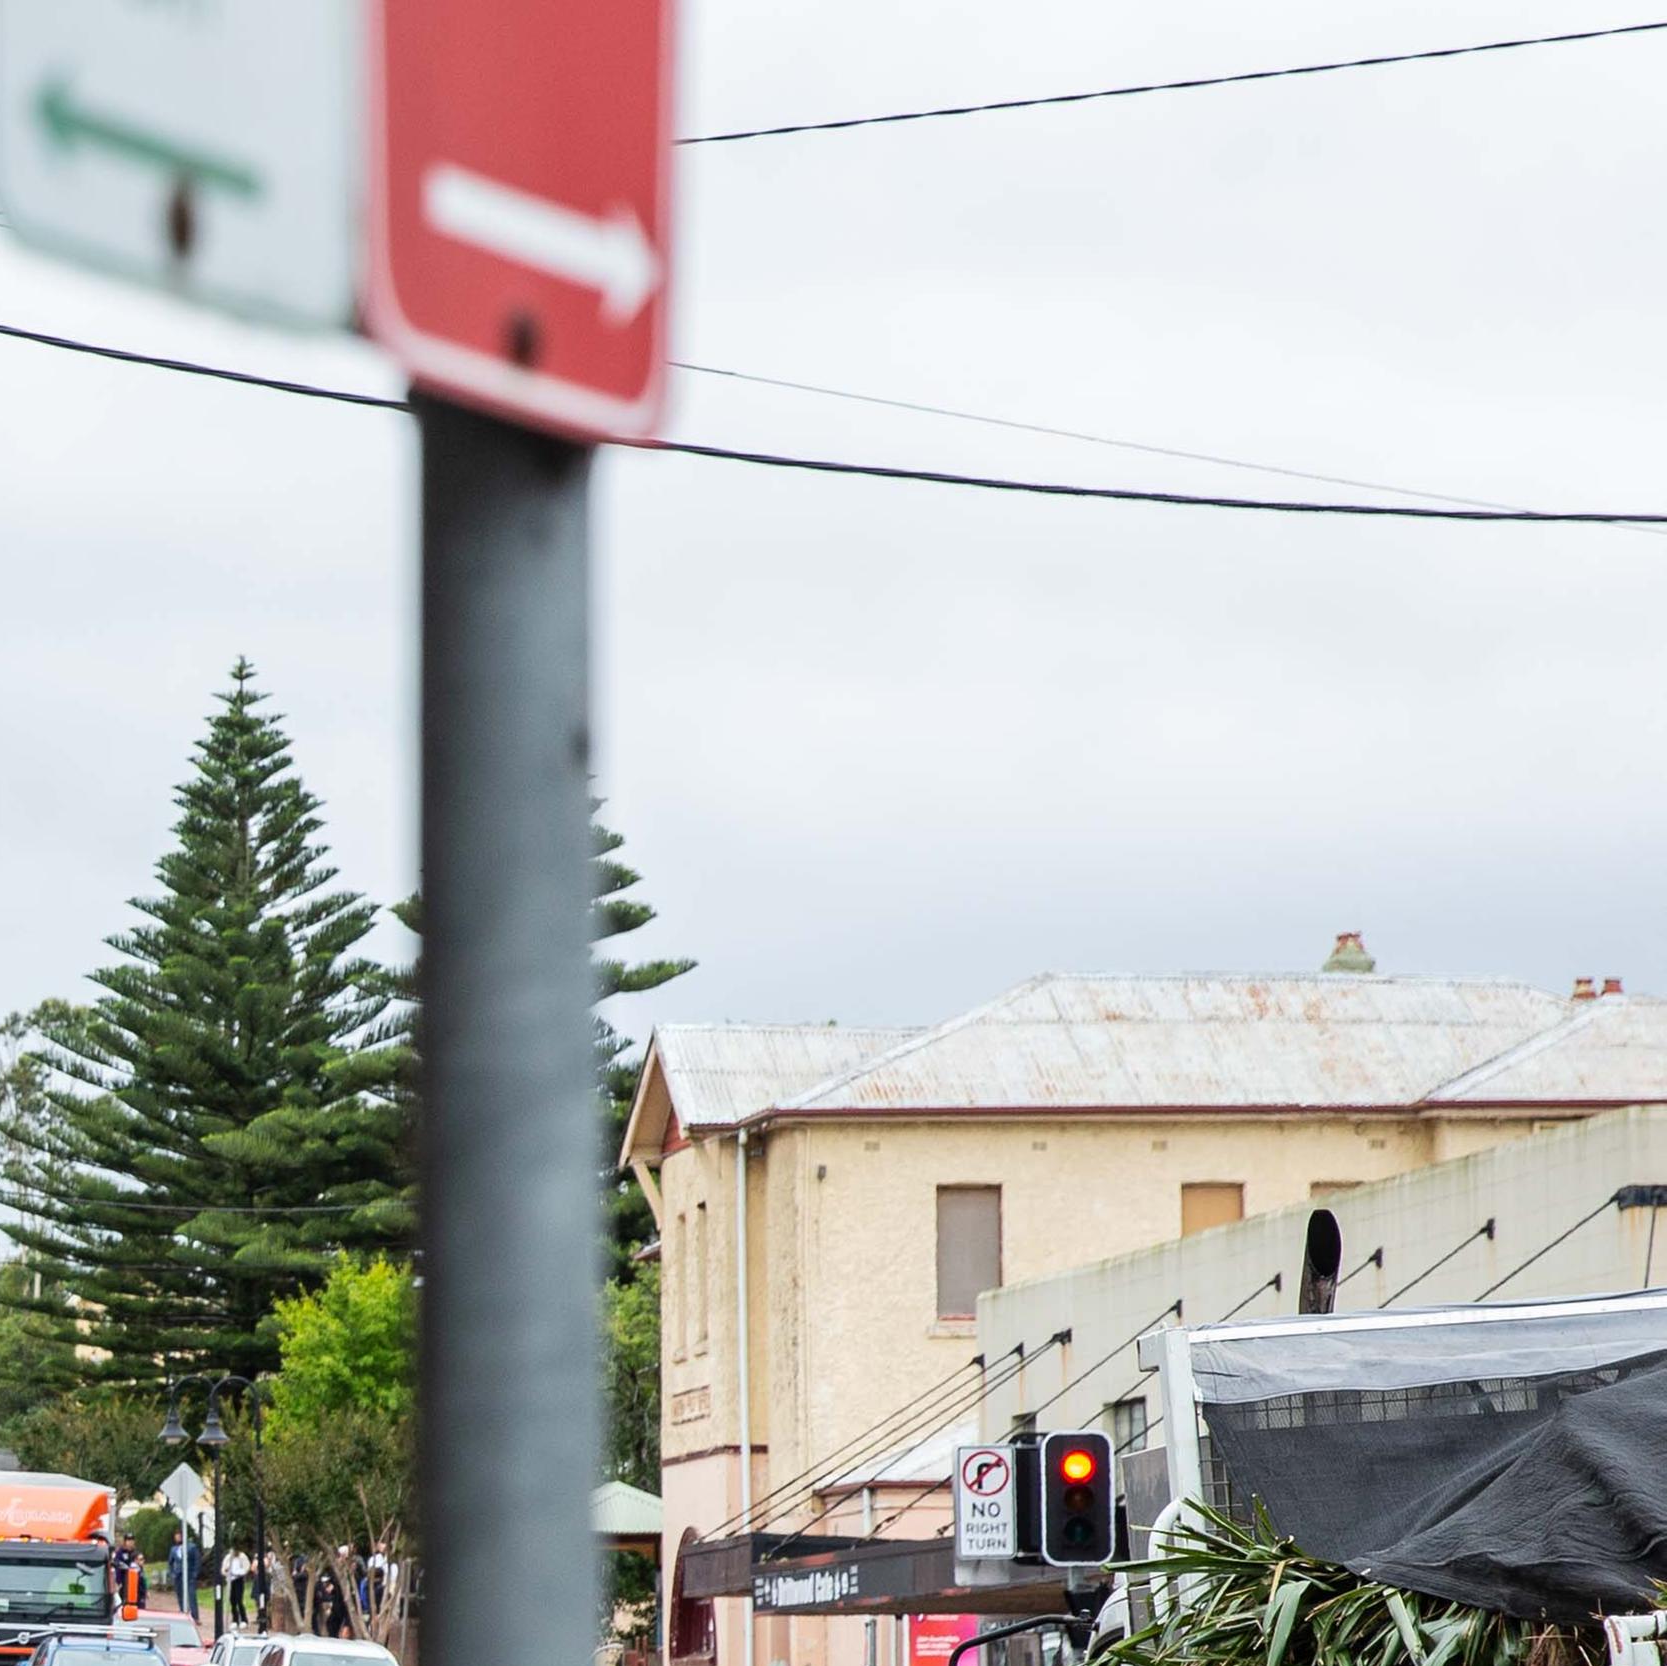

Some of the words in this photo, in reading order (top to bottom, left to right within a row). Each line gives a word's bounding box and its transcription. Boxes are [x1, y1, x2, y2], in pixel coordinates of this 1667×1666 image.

[972, 1502, 1001, 1518] NO
[966, 1523, 1008, 1534] RIGHT
[967, 1539, 1007, 1550] TURN
